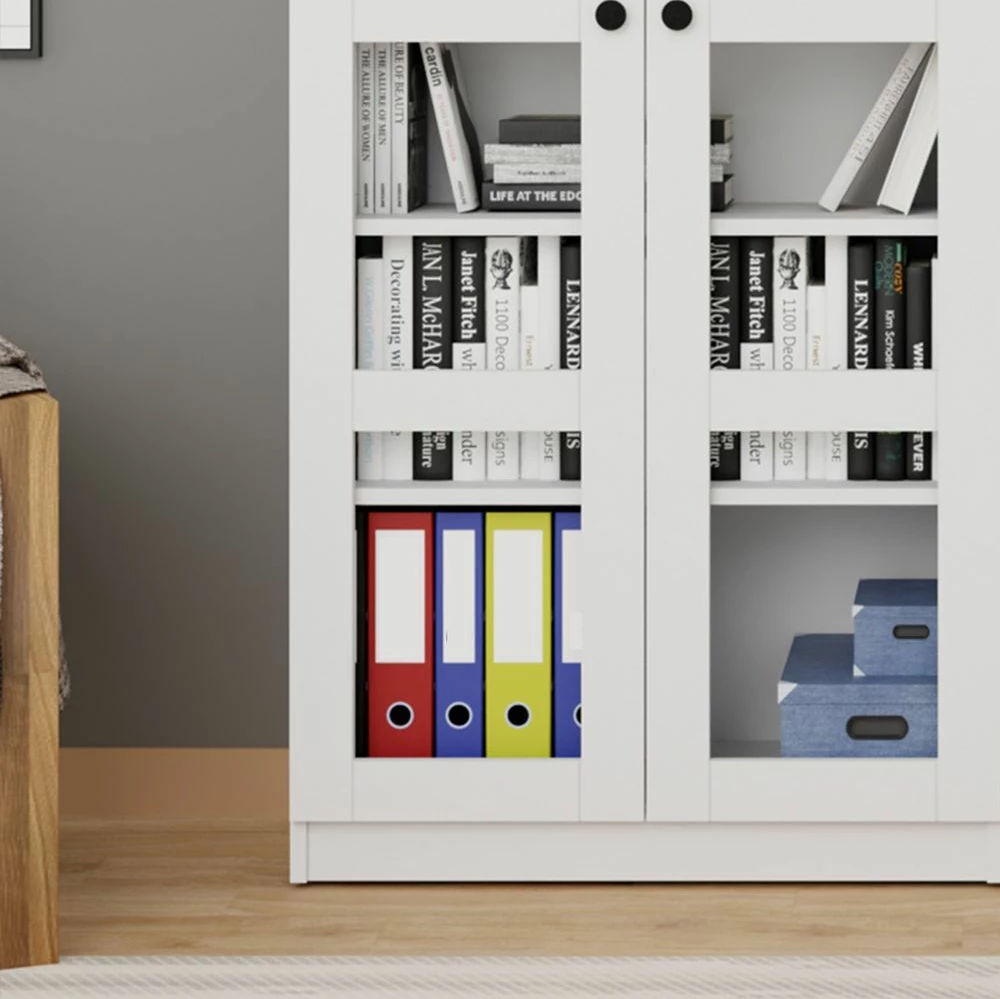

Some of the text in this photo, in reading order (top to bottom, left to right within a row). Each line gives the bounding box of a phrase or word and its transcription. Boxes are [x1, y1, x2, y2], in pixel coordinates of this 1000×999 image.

[378, 49, 386, 146] THE ALLURE OF MEN
[394, 65, 404, 126] OF BEAUTY
[425, 47, 442, 87] cardin
[361, 49, 371, 161] THE ALLURE OF WOMEN
[490, 191, 514, 201] LIFE
[515, 191, 530, 201] AT
[533, 191, 556, 201] THE
[422, 242, 442, 271] JAN
[710, 242, 730, 271] JAN
[388, 259, 405, 345] Decorating
[461, 250, 477, 340] Janet Fitch
[495, 299, 509, 332] 1100
[566, 279, 581, 369] LENNARD
[749, 250, 765, 340] Janet Fitch
[782, 299, 796, 332] 1100
[854, 279, 869, 369] LENNARD
